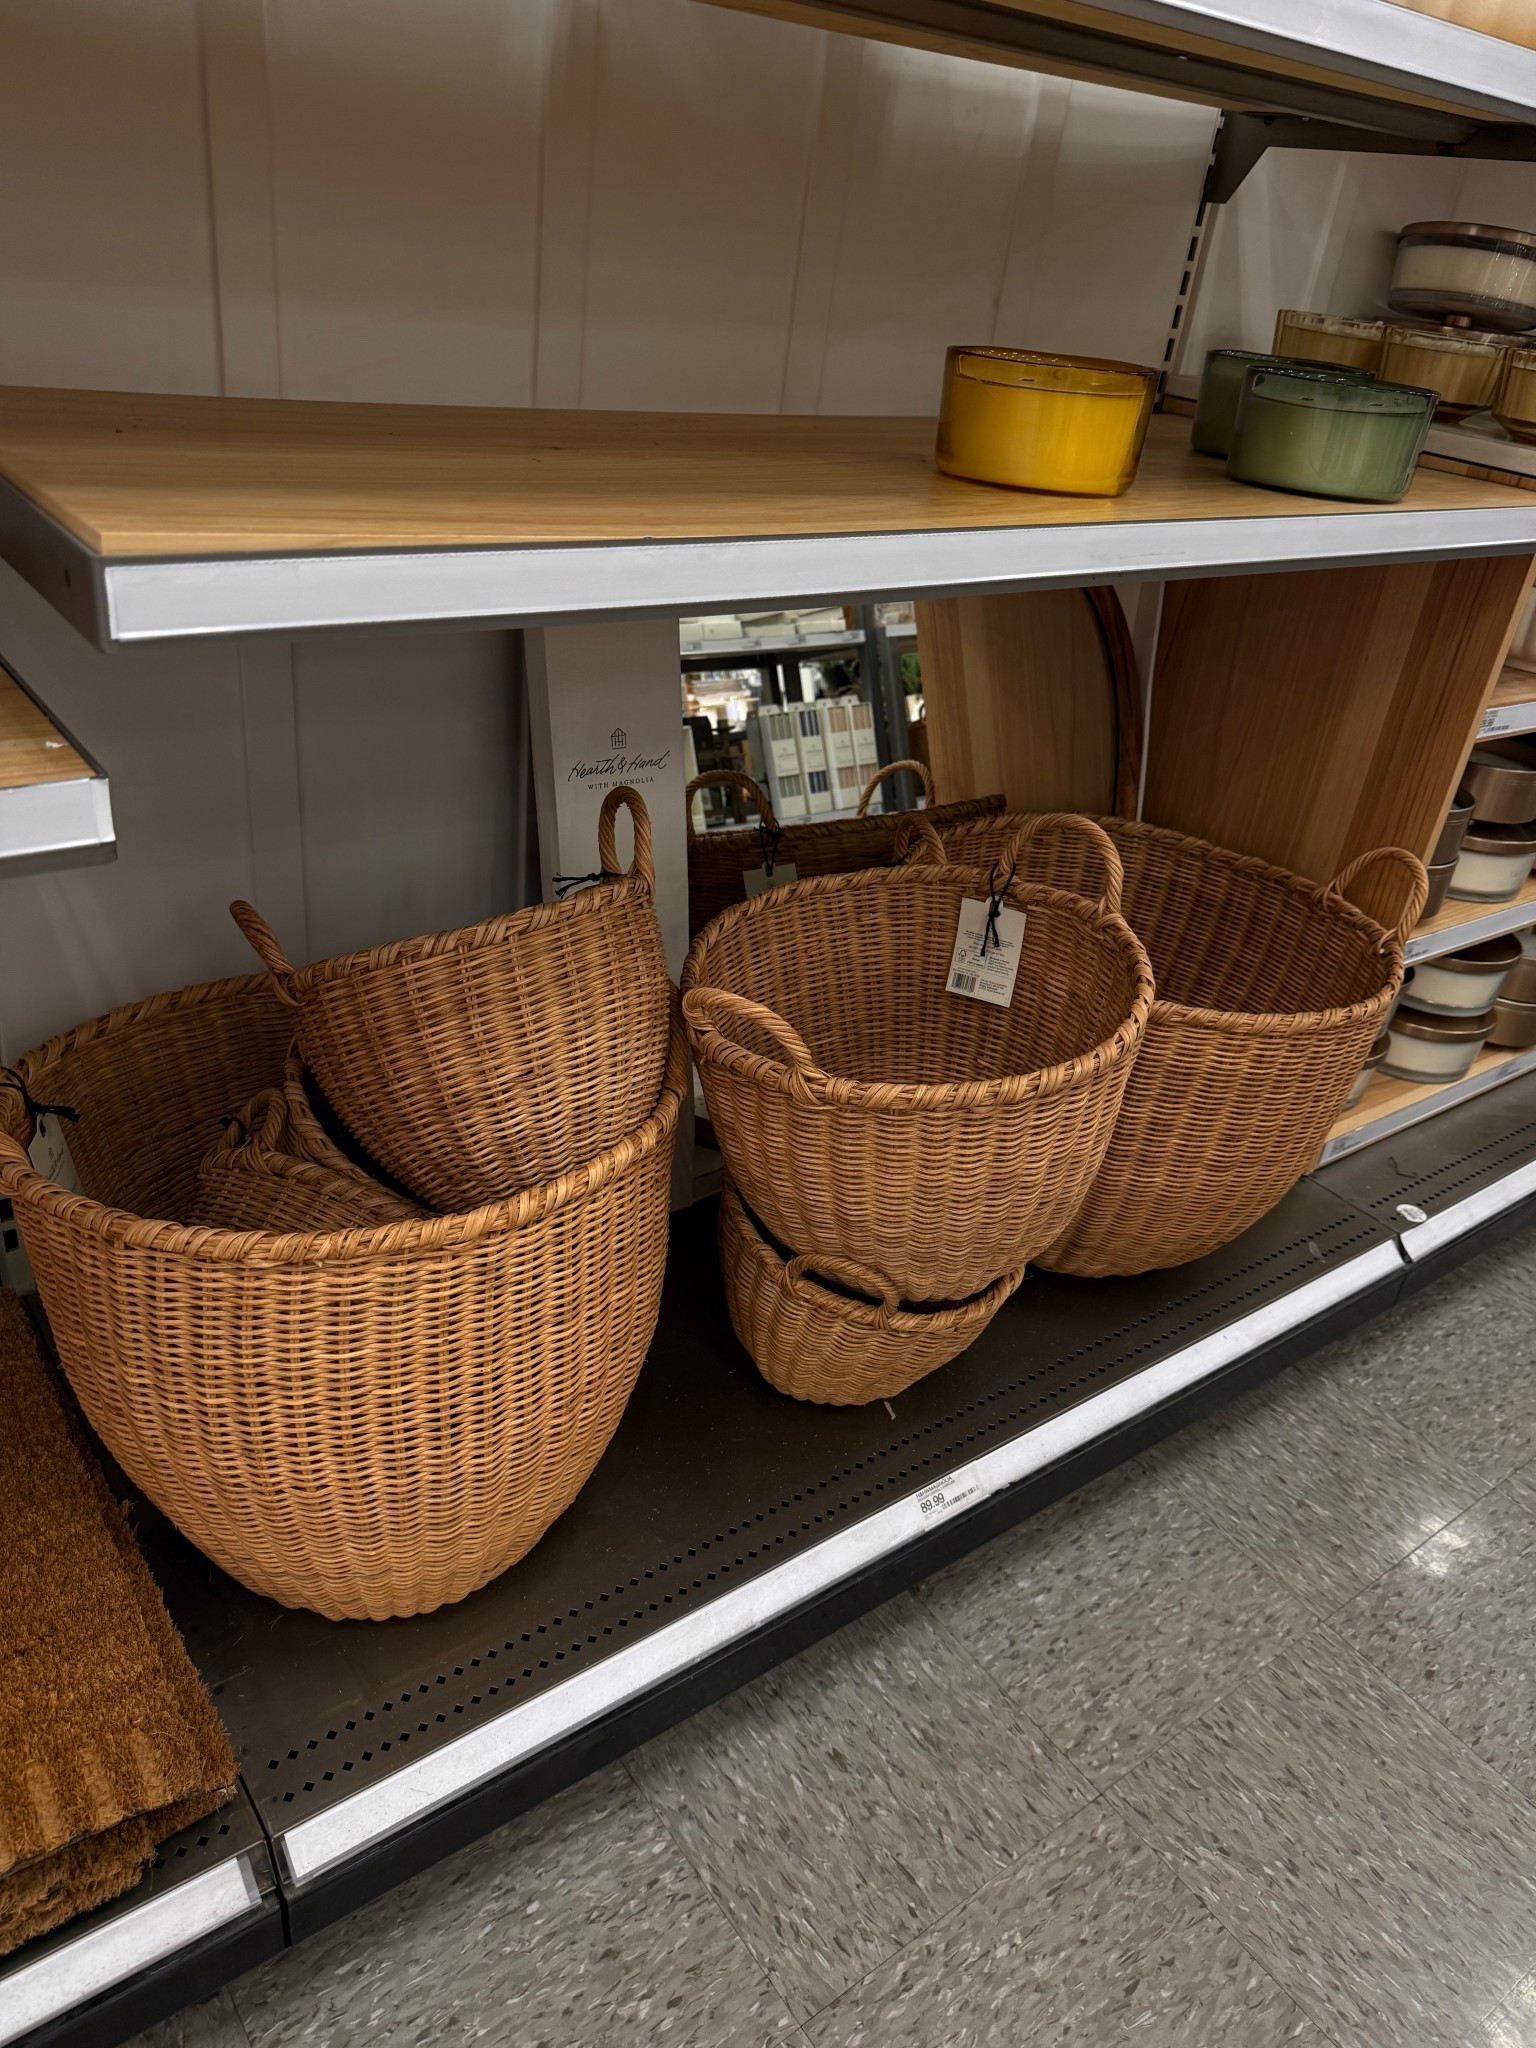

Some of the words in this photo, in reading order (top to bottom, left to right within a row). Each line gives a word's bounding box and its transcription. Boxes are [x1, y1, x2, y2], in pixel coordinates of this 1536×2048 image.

[567, 754, 619, 782] Hearth
[617, 756, 628, 775] &
[627, 749, 670, 773] Hand
[587, 781, 609, 790] WITH
[612, 776, 654, 788] MAGNOLIA
[920, 1492, 945, 1514] 89.99
